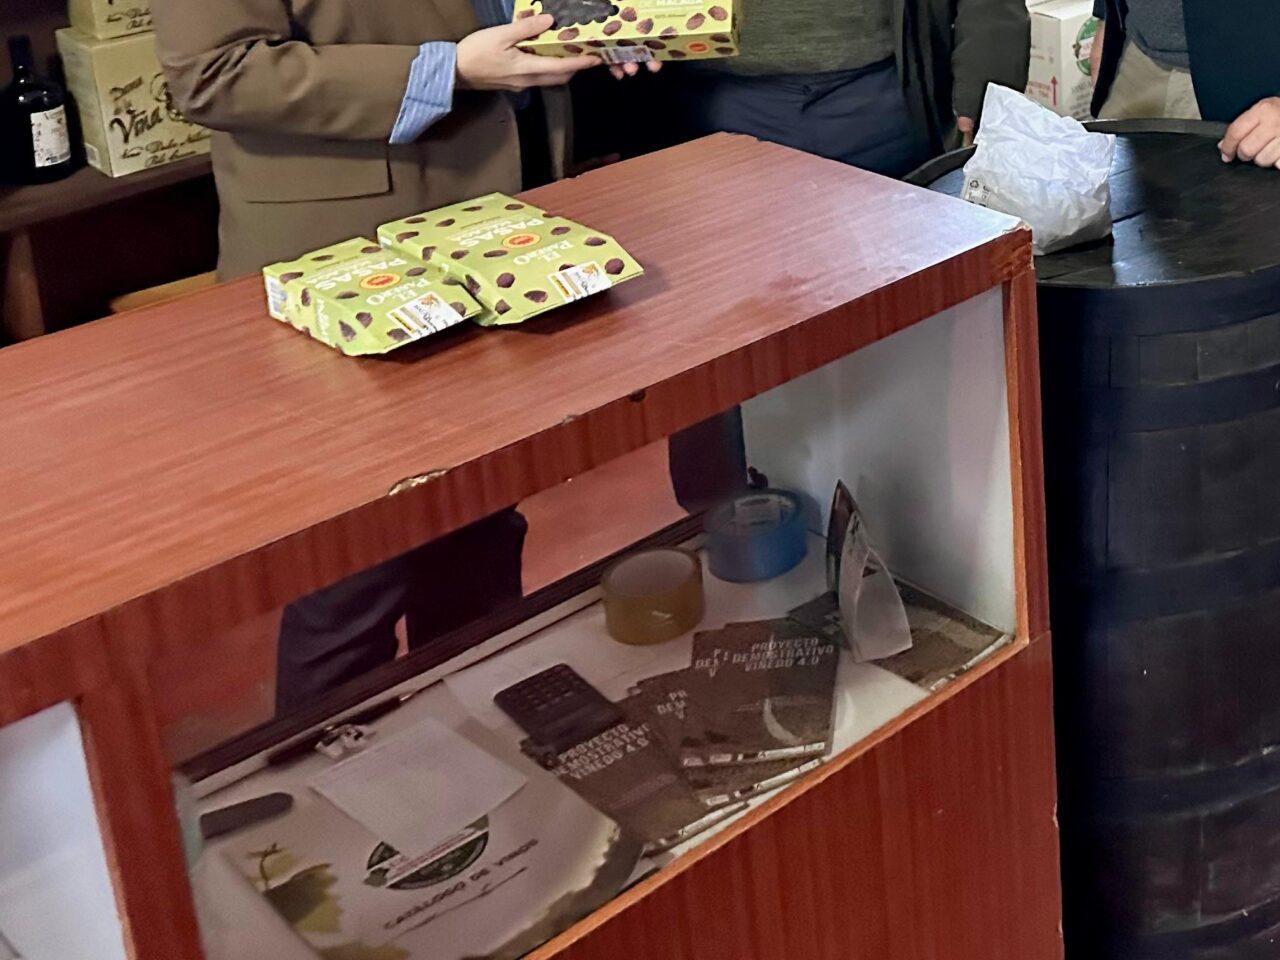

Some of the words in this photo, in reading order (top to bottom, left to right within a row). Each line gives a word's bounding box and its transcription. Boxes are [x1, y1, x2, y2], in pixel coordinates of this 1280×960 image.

[752, 637, 819, 652] PROYECTO
[733, 645, 834, 664] DEMOSTRATIVO
[797, 657, 820, 667] 4.0
